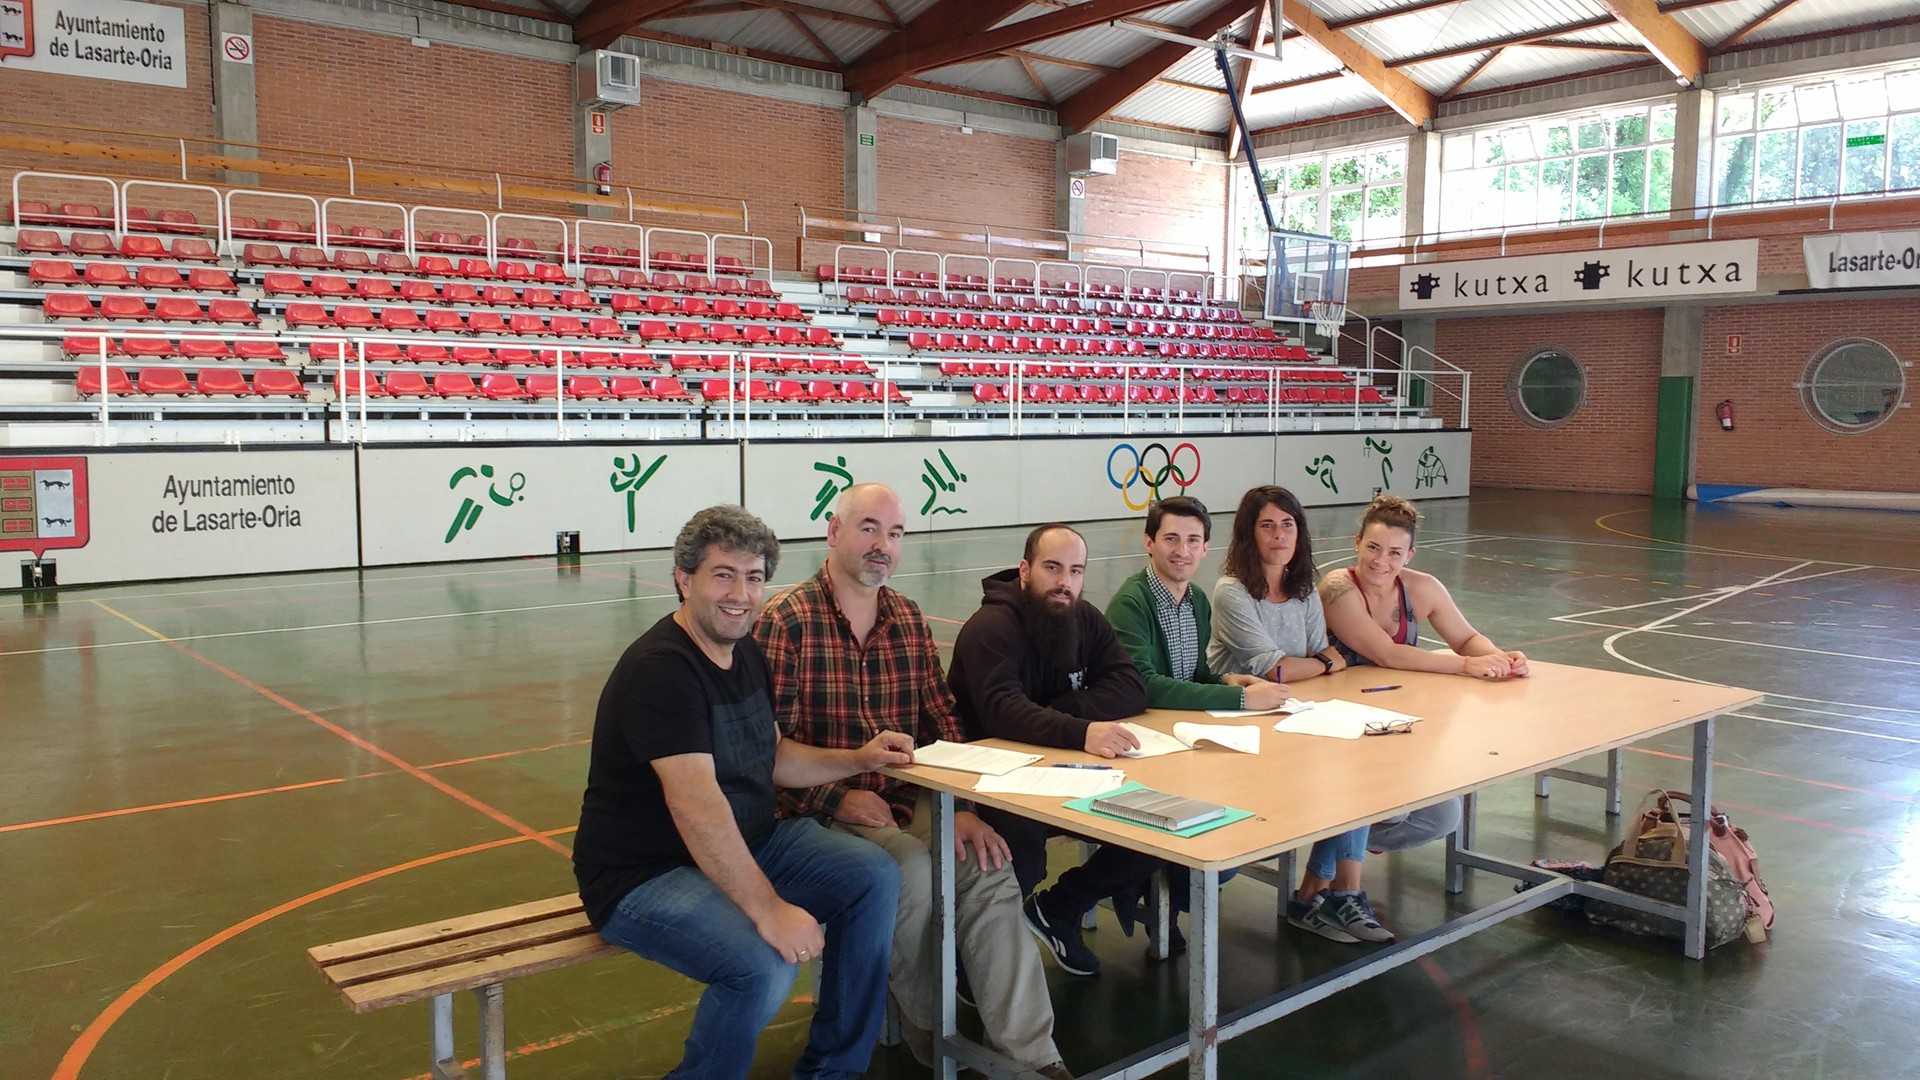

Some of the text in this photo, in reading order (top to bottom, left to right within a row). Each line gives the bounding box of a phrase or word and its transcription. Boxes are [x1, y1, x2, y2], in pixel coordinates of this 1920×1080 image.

[55, 10, 165, 43] Ayuntamiento
[49, 37, 172, 70] de Lasarte-Oria
[1454, 260, 1742, 298] kutxa kutxa
[162, 474, 295, 505] Ayuntamiento
[152, 504, 301, 533] de Lasarte-Oria
